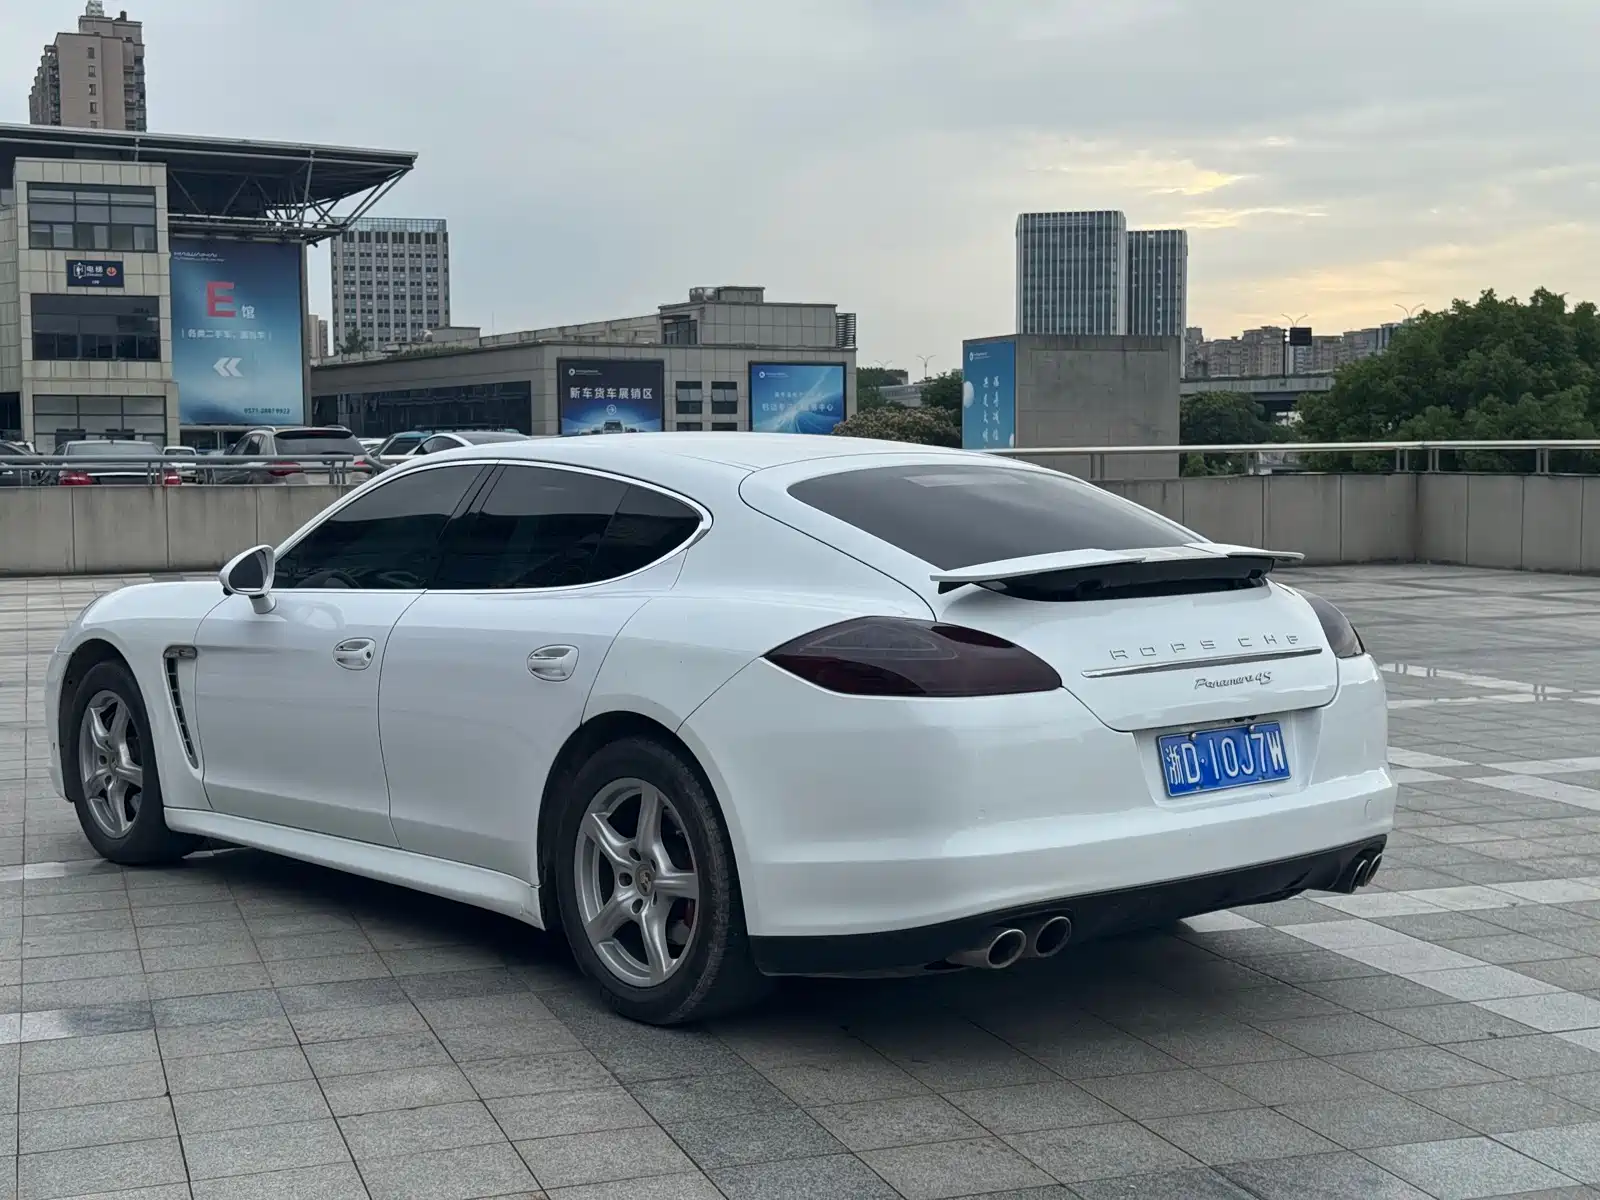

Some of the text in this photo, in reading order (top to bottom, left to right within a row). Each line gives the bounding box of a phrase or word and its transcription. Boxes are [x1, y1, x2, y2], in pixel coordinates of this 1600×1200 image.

[86, 265, 103, 273] 电梯
[206, 281, 237, 318] E
[241, 305, 256, 319] 馆
[569, 387, 654, 400] 新车货车展销区
